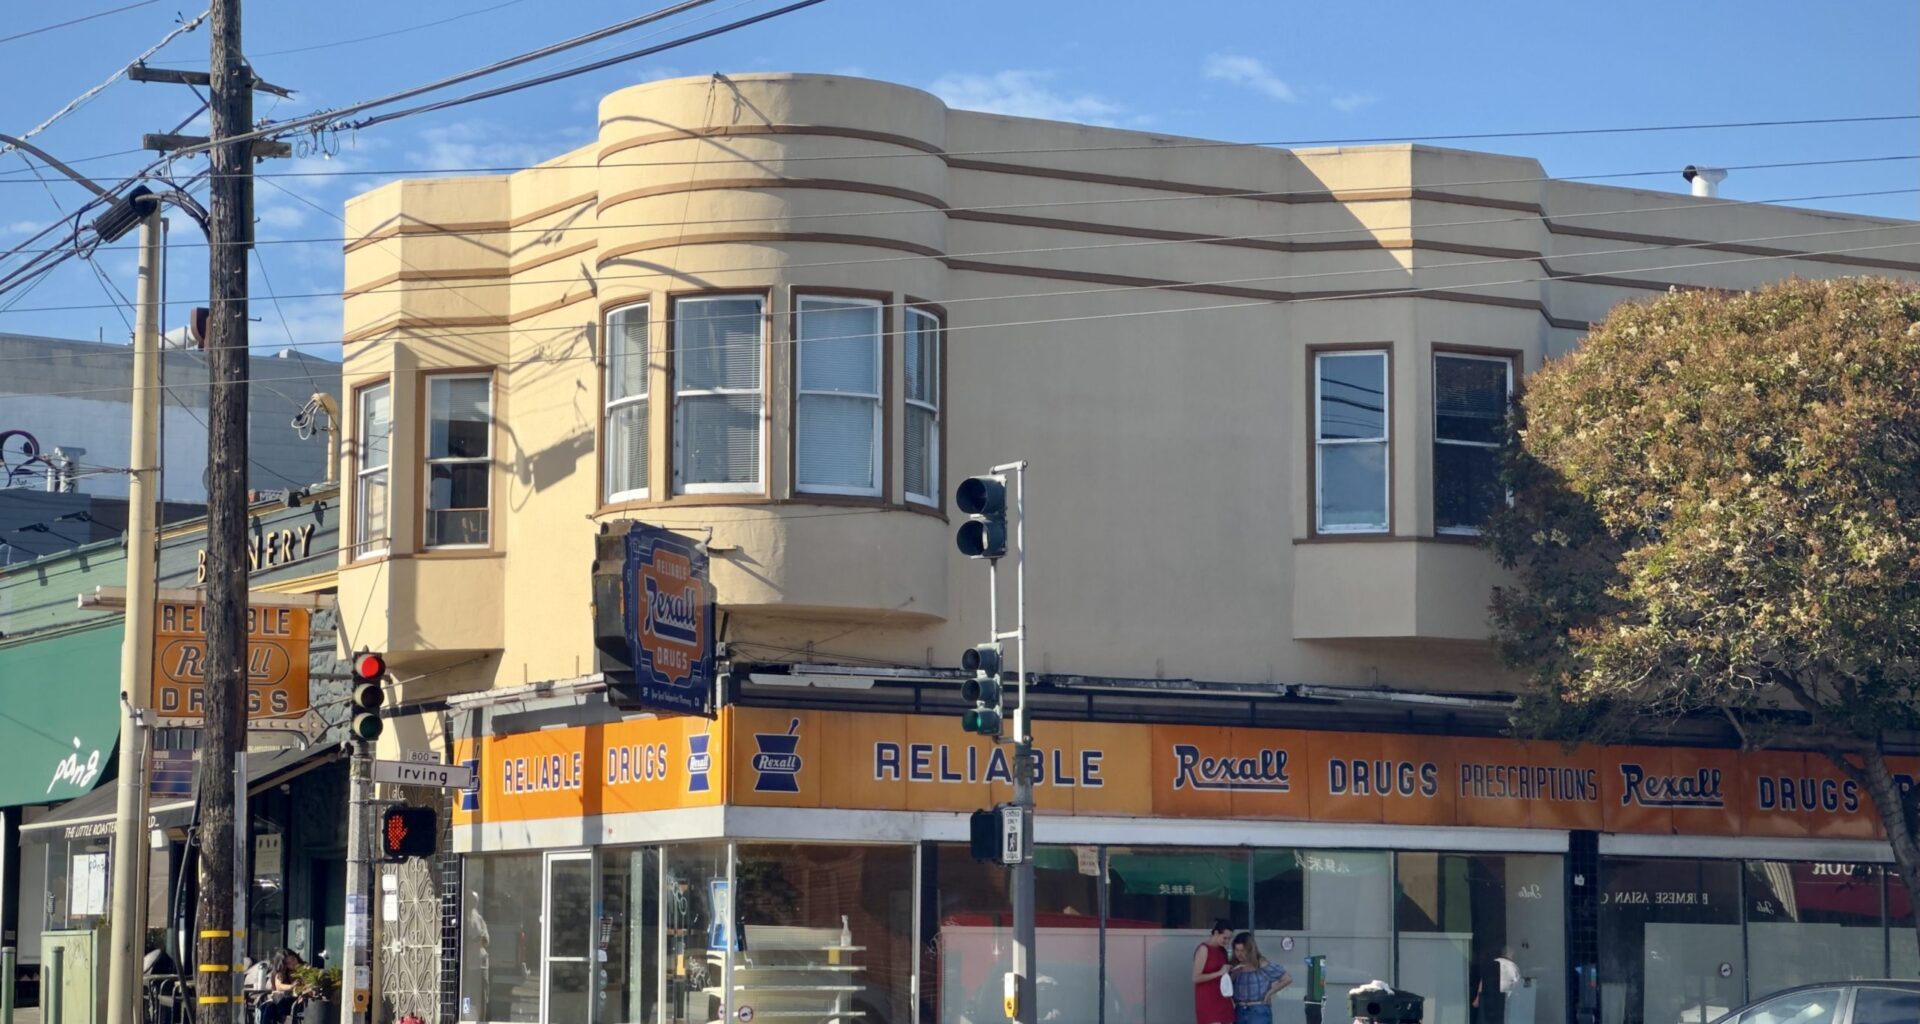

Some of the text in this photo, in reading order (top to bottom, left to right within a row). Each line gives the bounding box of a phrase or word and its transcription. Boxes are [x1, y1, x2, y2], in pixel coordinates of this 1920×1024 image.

[198, 524, 313, 583] BNERY
[656, 559, 687, 580] RELIABLE
[161, 604, 290, 635] REBLE
[643, 573, 698, 647] Rexall
[174, 645, 272, 677] Rll
[656, 646, 688, 669] DRUGS
[160, 687, 289, 715] DRGS
[411, 752, 430, 761] 800
[503, 751, 582, 795] RELIABLE
[607, 742, 667, 785] DRUGS
[758, 754, 796, 771] Rexall
[873, 741, 1104, 788] RELIABLE
[397, 766, 448, 786] Irving
[1173, 744, 1289, 792] Rexall
[1328, 758, 1438, 798] DRUGS
[1460, 762, 1598, 801] PRESCRIPTIONS
[1620, 763, 1724, 809] Rexall
[1757, 775, 1859, 814] DRUGS
[92, 821, 118, 837] ROASTE
